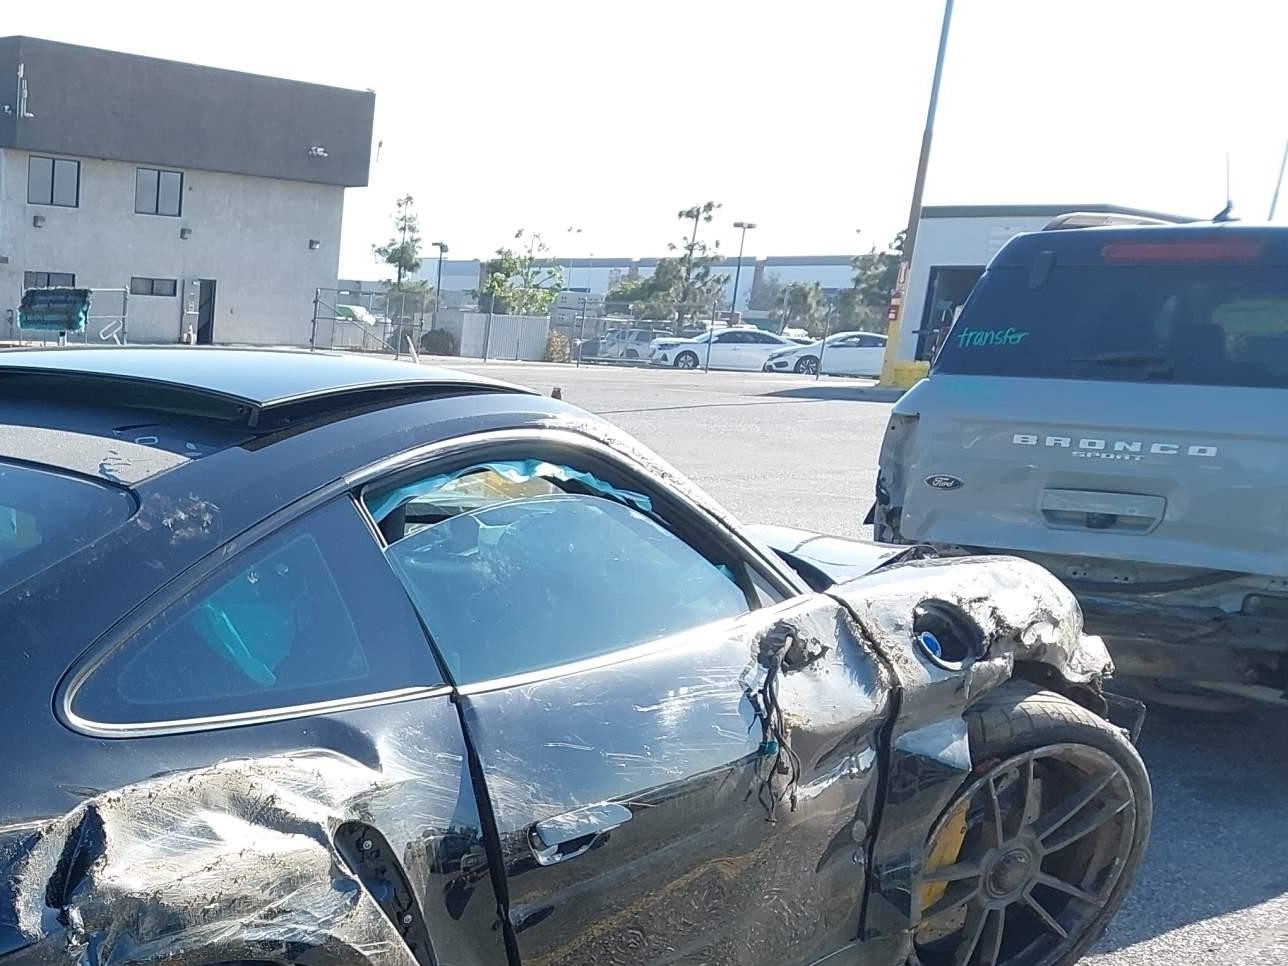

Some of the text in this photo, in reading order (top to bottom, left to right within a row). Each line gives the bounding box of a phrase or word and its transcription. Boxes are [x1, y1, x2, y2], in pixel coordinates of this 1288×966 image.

[957, 327, 1030, 348] transfer
[1012, 434, 1218, 457] BRONCO
[1072, 451, 1146, 461] SPORT
